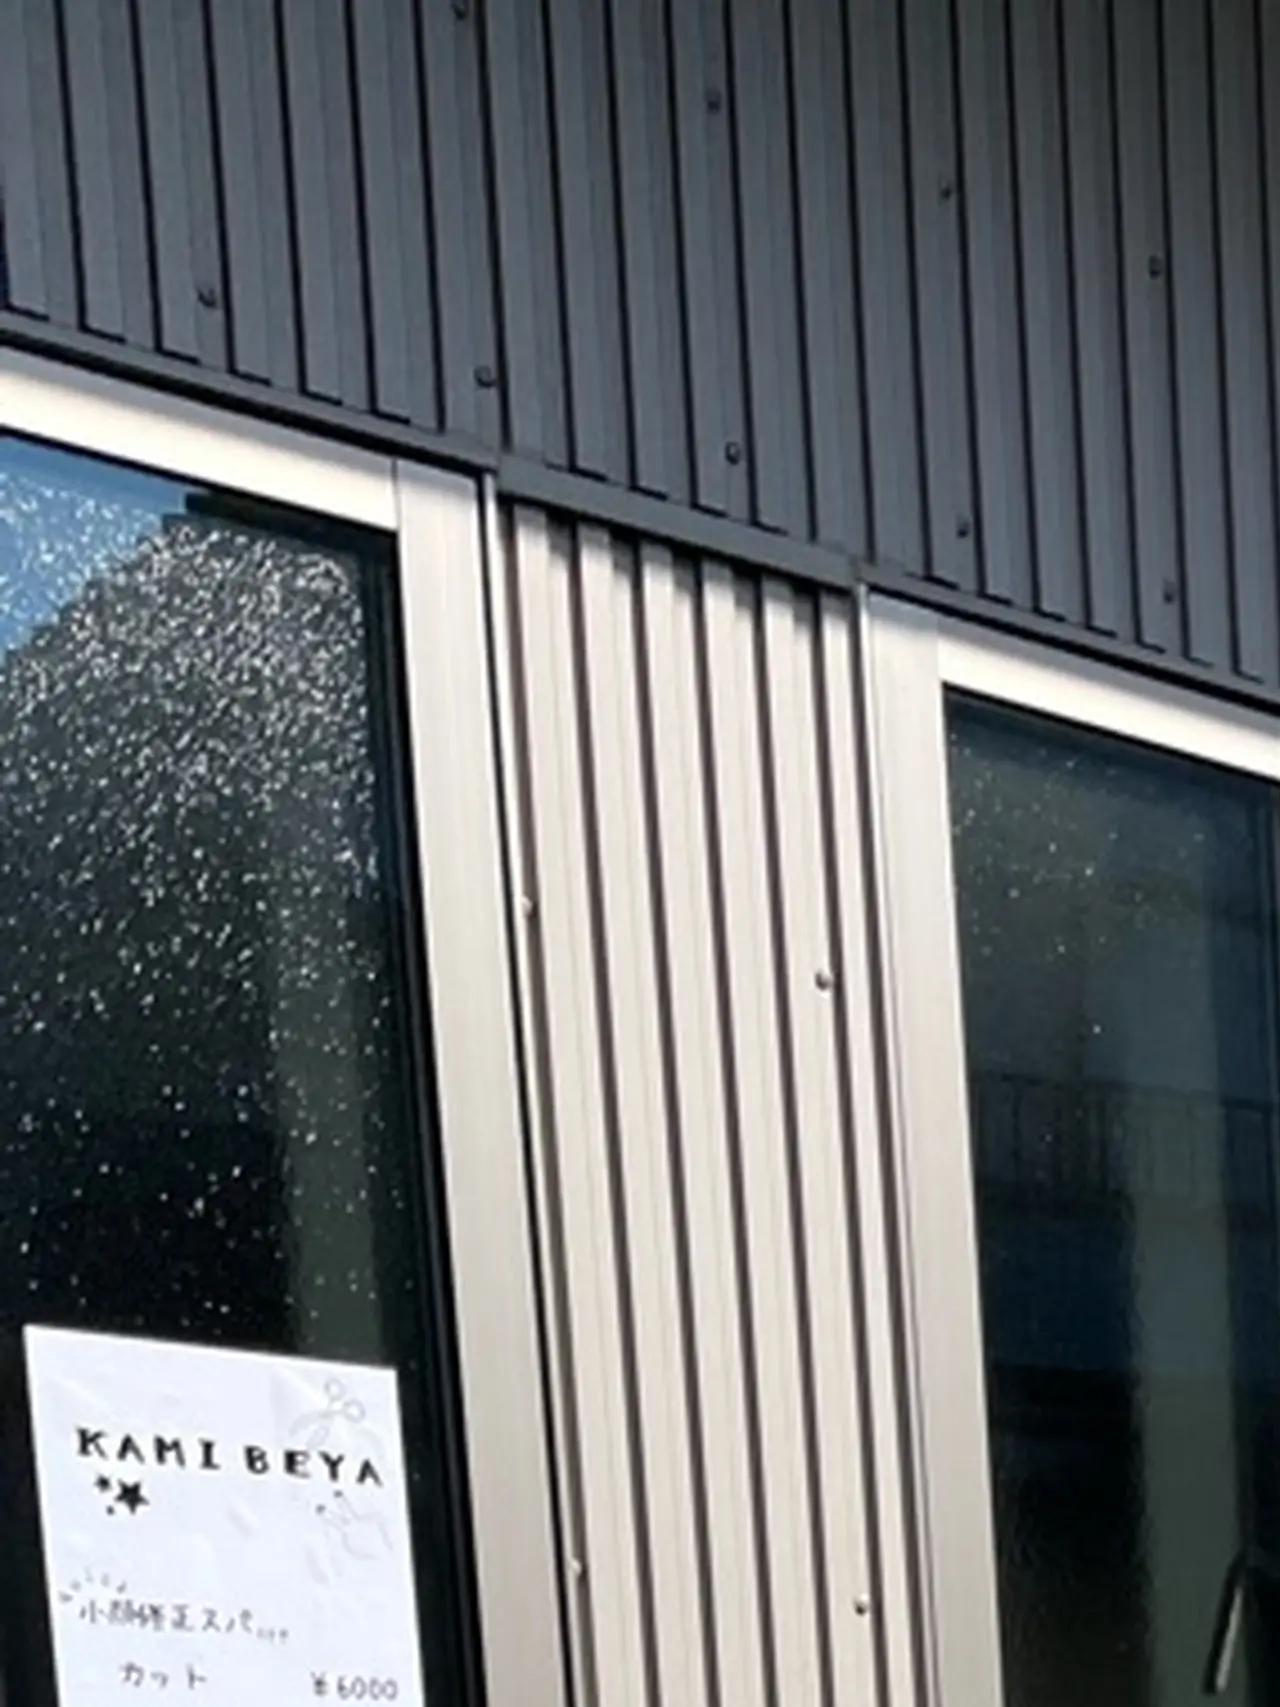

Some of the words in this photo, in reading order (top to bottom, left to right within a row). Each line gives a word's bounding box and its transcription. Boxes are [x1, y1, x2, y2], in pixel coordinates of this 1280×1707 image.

[75, 1425, 221, 1470] KAMI
[243, 1445, 384, 1488] BEYA
[119, 1661, 207, 1690] カット
